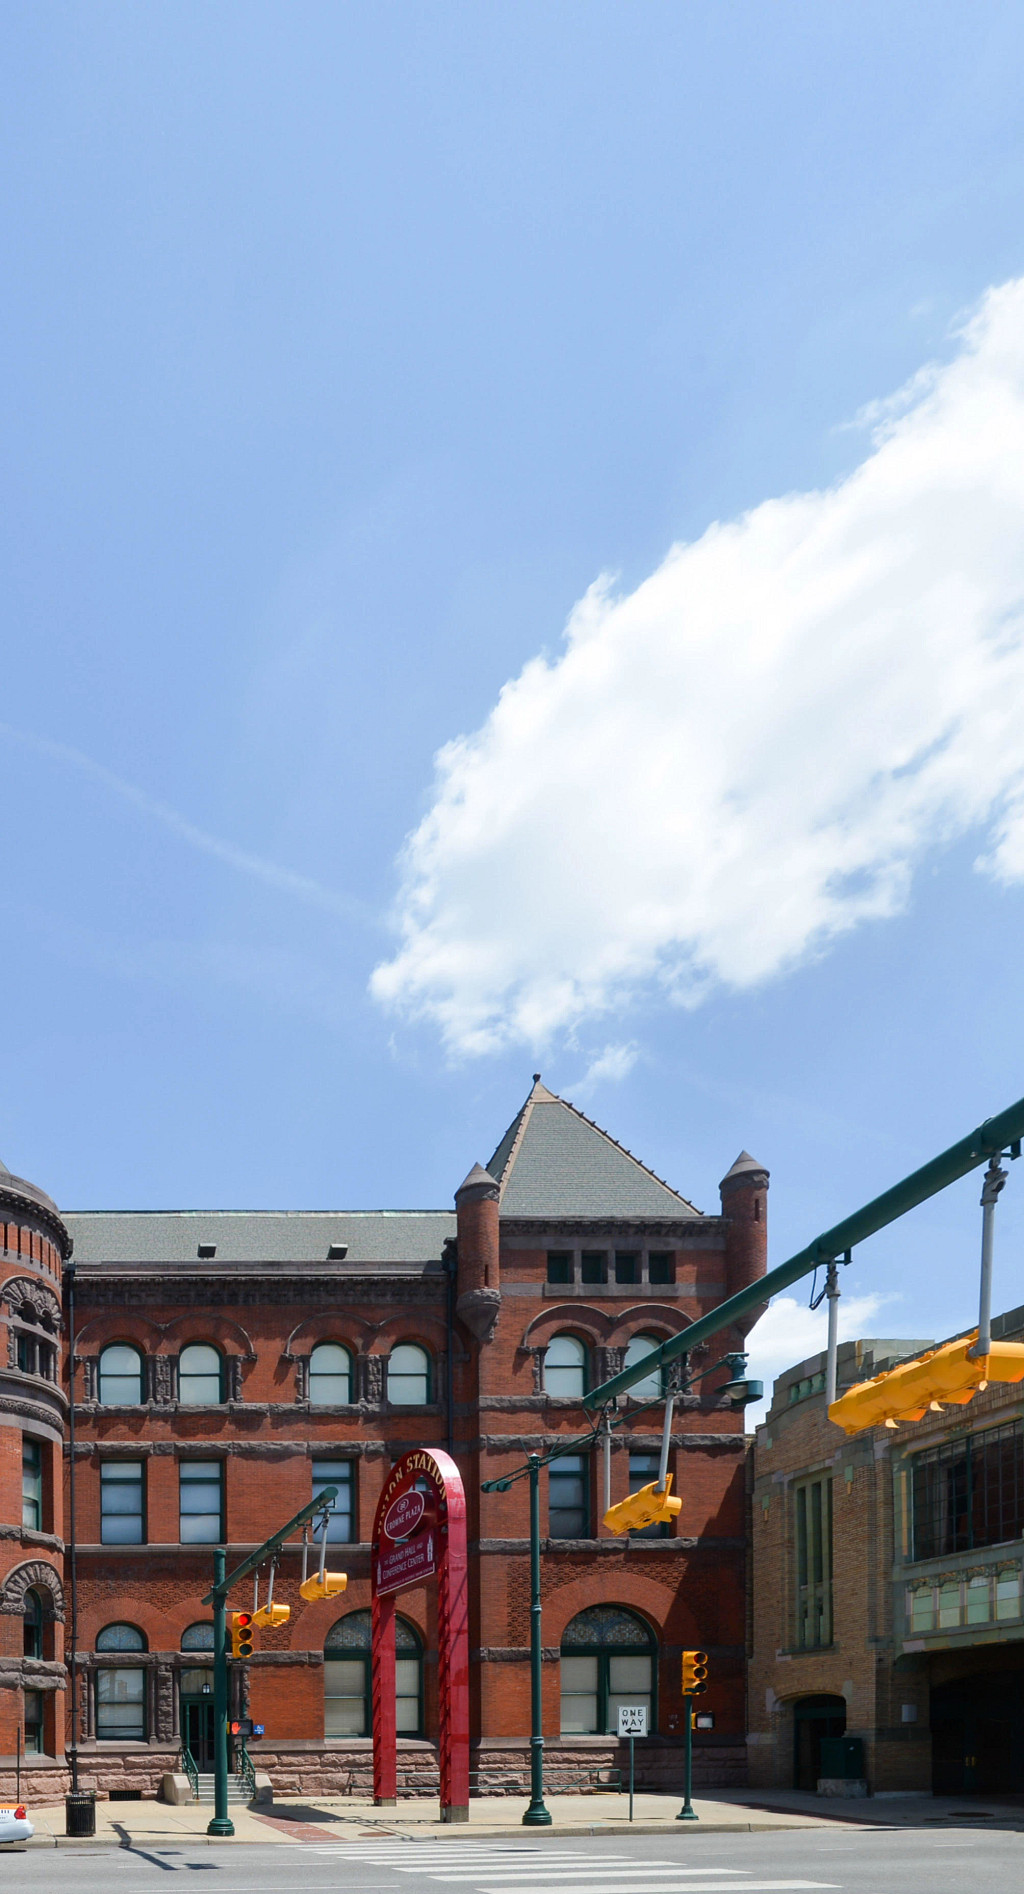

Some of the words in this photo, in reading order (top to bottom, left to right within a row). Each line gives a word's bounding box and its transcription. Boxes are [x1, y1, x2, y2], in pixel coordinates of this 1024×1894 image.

[387, 1513, 405, 1532] CROWNE
[405, 1504, 421, 1520] PLAZA
[383, 1561, 407, 1580] CONFERENCE
[407, 1553, 425, 1568] CENTER
[389, 1550, 404, 1565] GRAND
[404, 1544, 416, 1557] HALL
